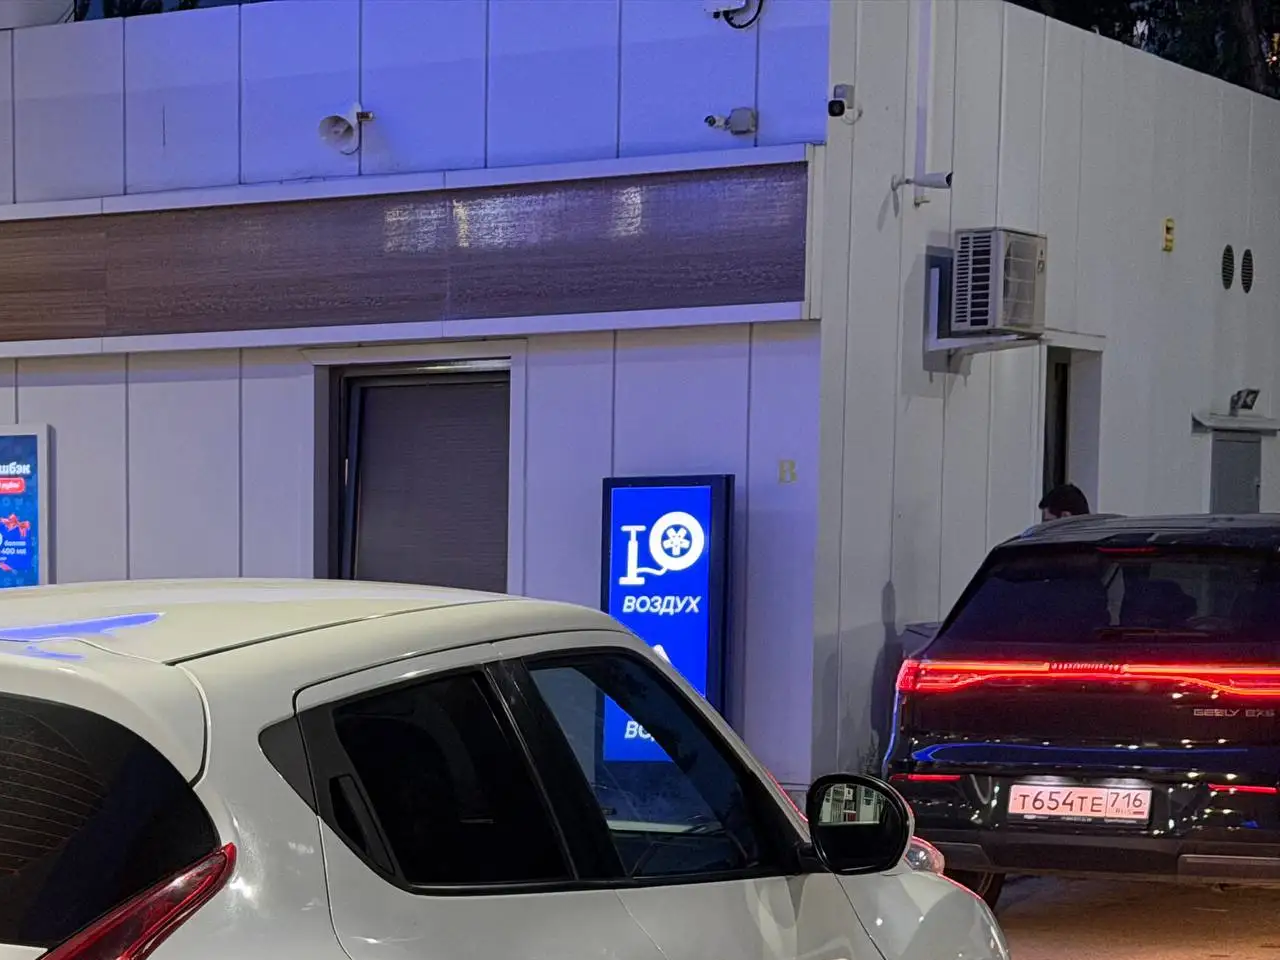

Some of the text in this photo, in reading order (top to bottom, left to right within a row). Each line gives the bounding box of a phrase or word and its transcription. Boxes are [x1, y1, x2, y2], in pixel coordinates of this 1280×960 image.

[623, 596, 702, 616] ВОЗДУХ
[1020, 791, 1143, 812] Т654ТЕ 716
